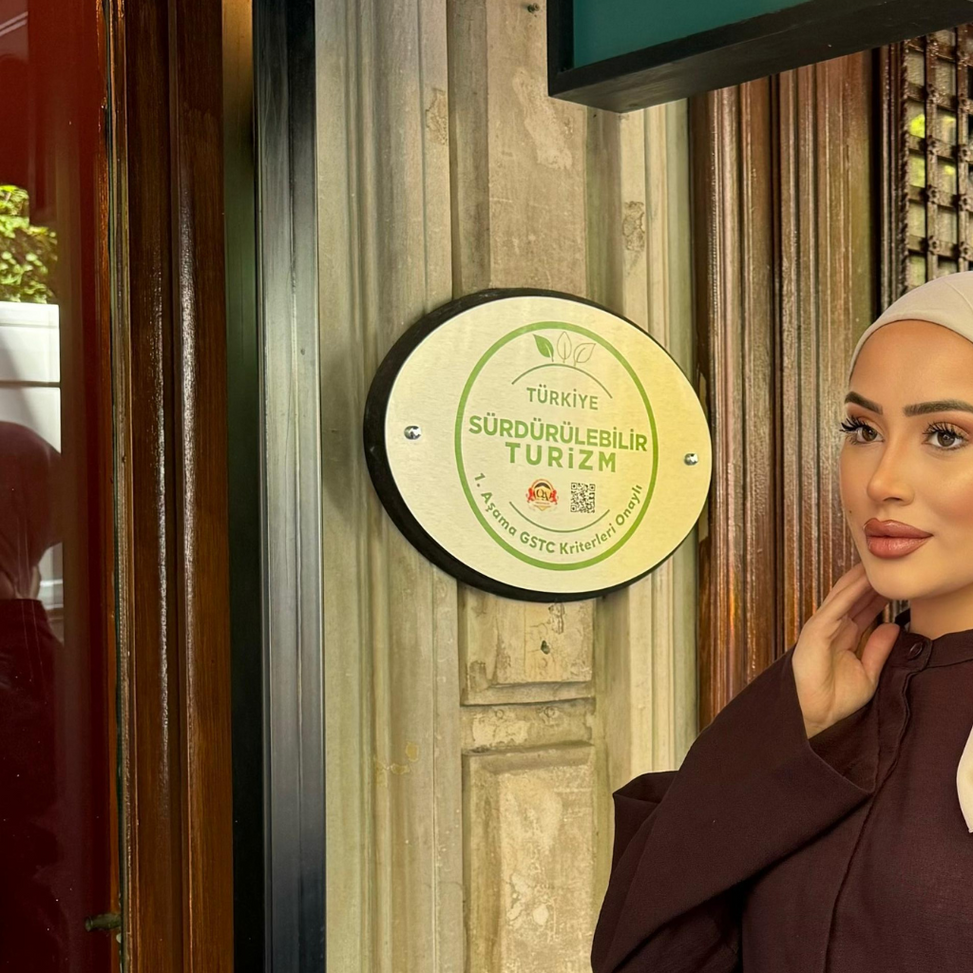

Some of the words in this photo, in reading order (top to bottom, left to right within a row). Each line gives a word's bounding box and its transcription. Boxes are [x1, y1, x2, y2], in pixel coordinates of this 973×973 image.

[526, 383, 599, 410] TÜRKİYE
[468, 412, 648, 452] SÜRDÜRÜLEBİLİR
[474, 472, 486, 488] 1.
[481, 491, 517, 536] Aşama
[519, 531, 556, 554] GSTC
[559, 523, 617, 555] Kriterleri
[615, 484, 643, 527] Onaylı
